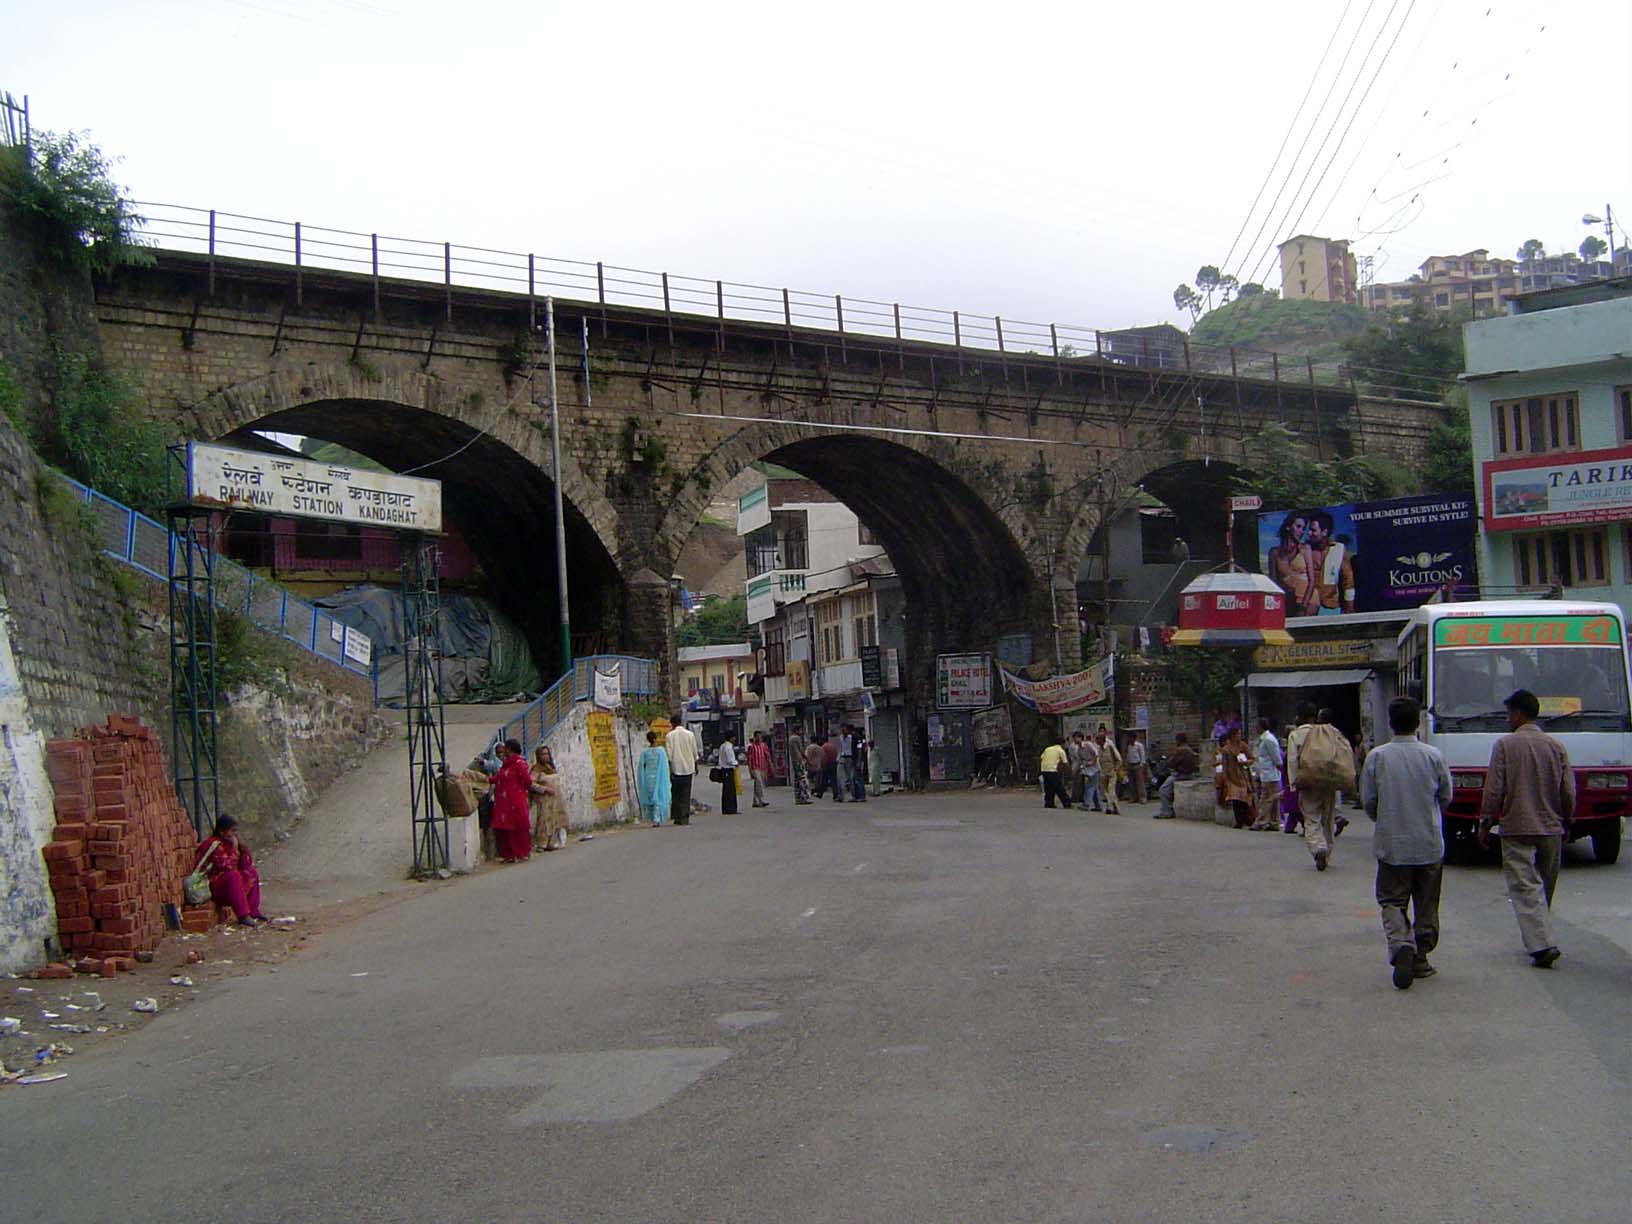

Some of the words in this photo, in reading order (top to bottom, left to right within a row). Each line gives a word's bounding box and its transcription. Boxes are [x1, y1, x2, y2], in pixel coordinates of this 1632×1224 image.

[221, 462, 264, 486] रेलवे
[280, 472, 333, 496] स्टेशन
[219, 485, 274, 506] RAILWAY
[293, 495, 344, 515] STATION
[359, 504, 417, 524] KANDAGHAT
[1349, 511, 1372, 521] YOUR
[1373, 507, 1409, 519] SUMMER
[1410, 503, 1450, 515] SURVIVAL
[1392, 515, 1428, 527] SURVIVE
[1428, 513, 1439, 523] IN
[1501, 622, 1569, 645] माता
[1580, 617, 1613, 642] दी
[1288, 643, 1333, 657] GENERAL
